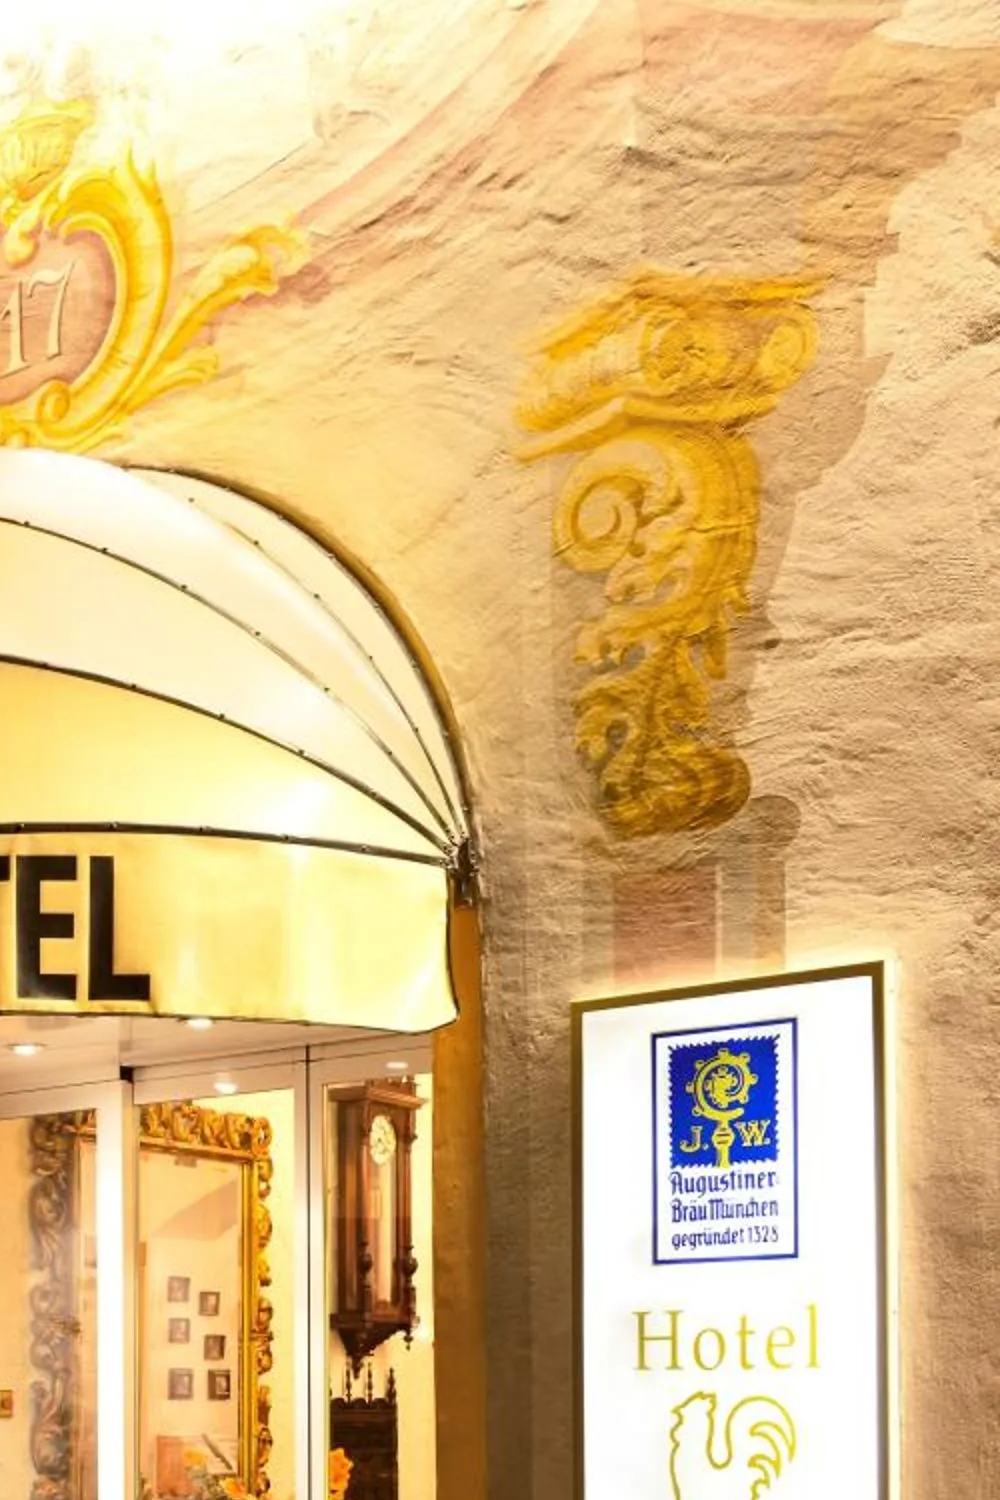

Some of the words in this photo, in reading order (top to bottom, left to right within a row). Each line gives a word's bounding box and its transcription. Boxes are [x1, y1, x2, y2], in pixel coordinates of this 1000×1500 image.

[671, 1198, 706, 1223] Bräu
[671, 1226, 745, 1251] gegründet
[632, 1303, 822, 1371] Hotel
